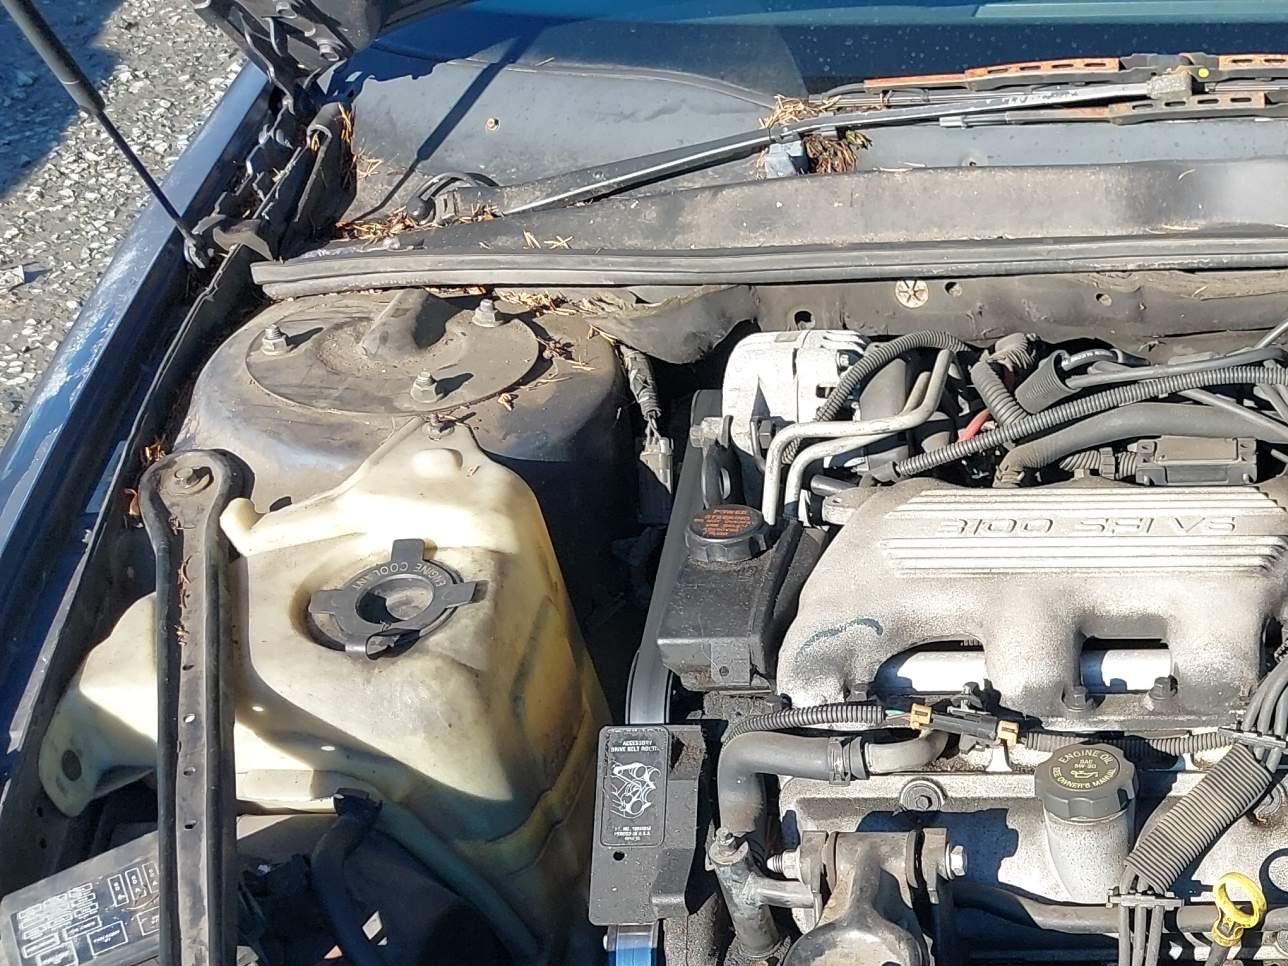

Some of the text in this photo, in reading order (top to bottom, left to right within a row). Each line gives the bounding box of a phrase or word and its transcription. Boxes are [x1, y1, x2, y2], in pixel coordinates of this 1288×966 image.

[940, 515, 1237, 535] 3100 SFI V6
[413, 562, 447, 587] ENGINE
[1058, 749, 1114, 765] ENGINE OIL
[1052, 766, 1062, 778] SEE
[1092, 768, 1117, 787] MANUAL
